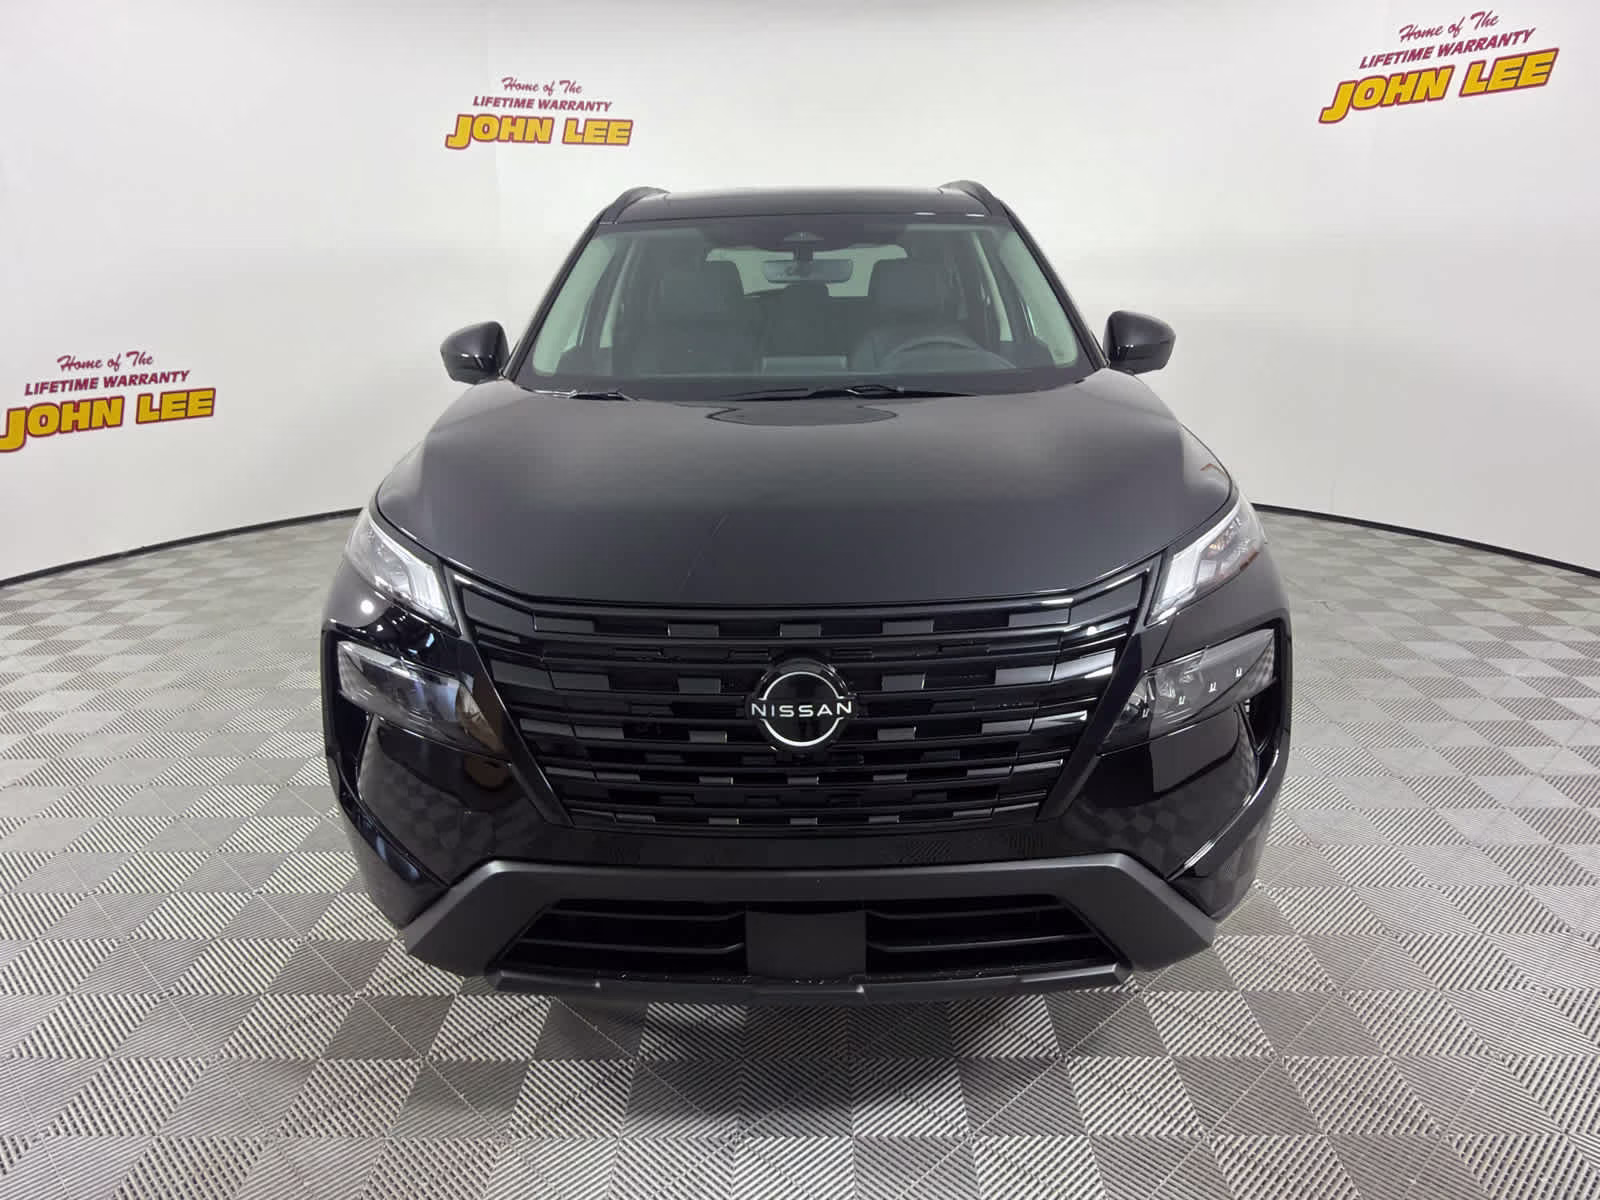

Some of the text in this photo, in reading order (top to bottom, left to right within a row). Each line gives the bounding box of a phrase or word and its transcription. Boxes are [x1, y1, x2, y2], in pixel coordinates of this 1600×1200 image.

[1399, 10, 1499, 43] Home of The
[1359, 28, 1536, 69] LIFETIME WARRANTY
[501, 77, 583, 96] Home of The
[1318, 47, 1560, 123] JOHN LEE
[472, 95, 612, 112] LIFETIME WARRANTY
[445, 113, 634, 150] JOHN LEE
[57, 350, 153, 372] Home of The
[24, 370, 190, 396] LIFETIME WARRANTY
[0, 387, 216, 453] JOHN LEE
[751, 700, 852, 718] NISSAN
